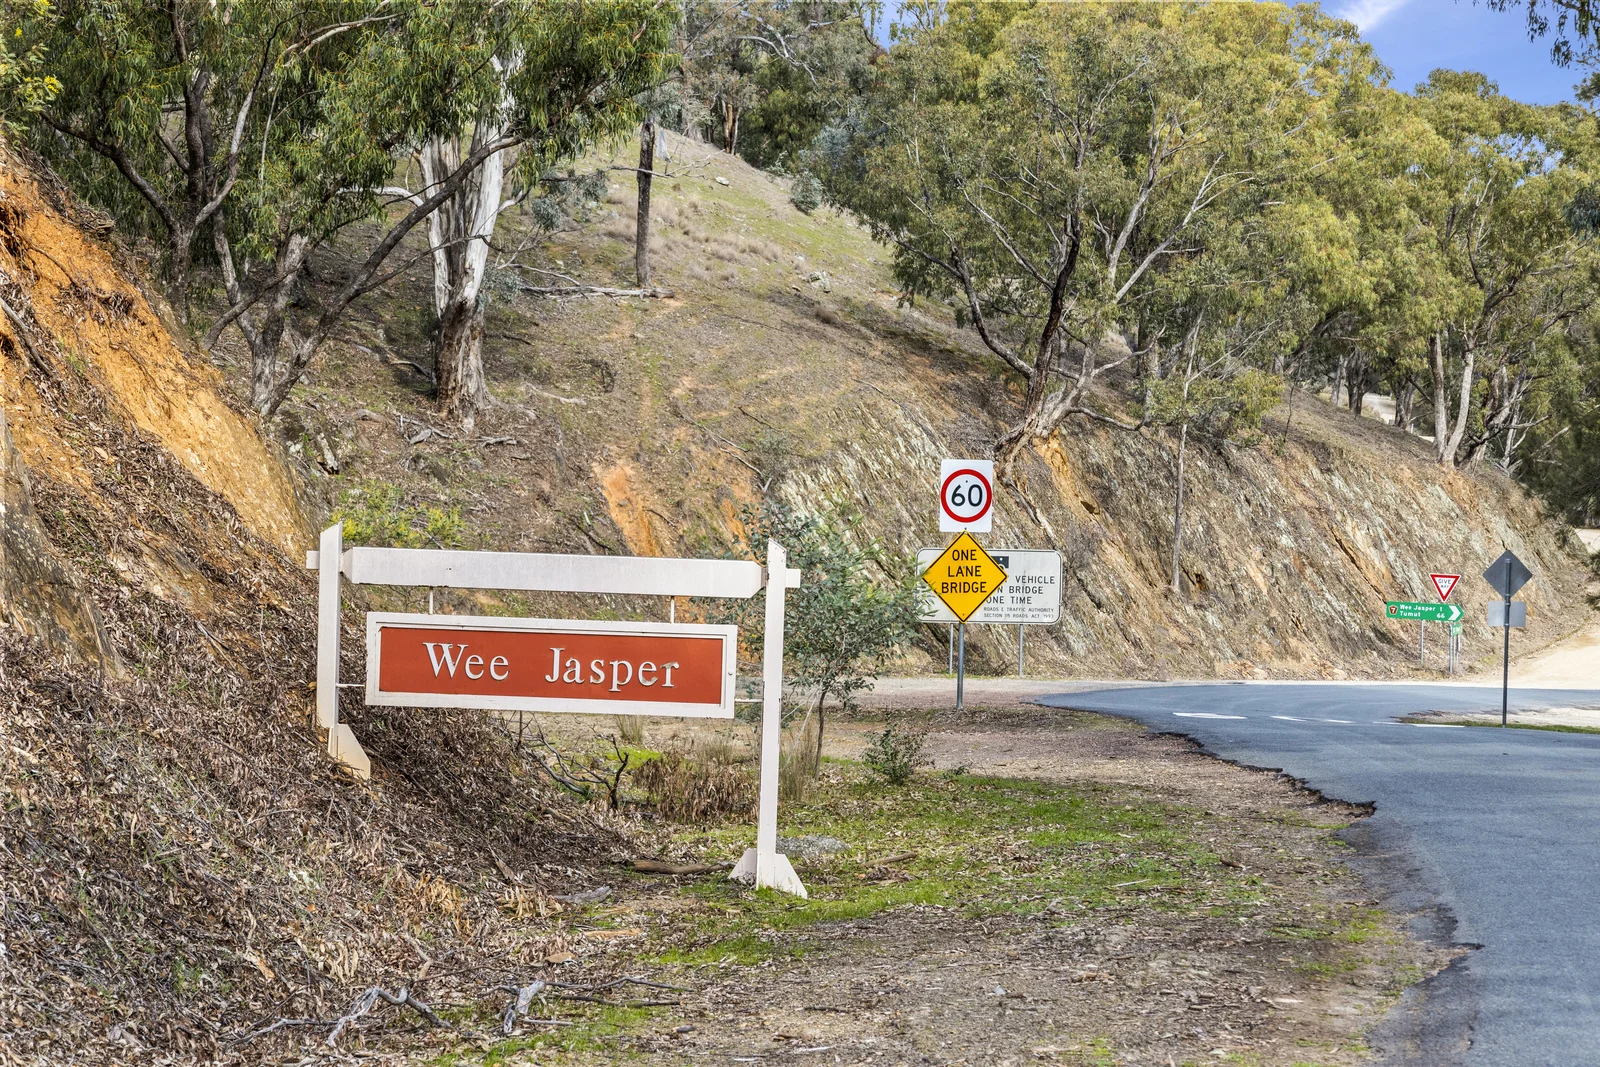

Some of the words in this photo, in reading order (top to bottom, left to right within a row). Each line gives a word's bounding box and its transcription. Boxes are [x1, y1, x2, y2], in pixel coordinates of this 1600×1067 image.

[951, 484, 983, 507] 60
[952, 549, 977, 561] ONE
[947, 566, 982, 578] LANE
[1015, 575, 1055, 584] VEHICLE
[941, 582, 987, 594] BRIDGE
[1009, 585, 1044, 594] BRIDGE
[1010, 596, 1032, 604] TIME
[422, 642, 510, 681] Wee
[545, 647, 680, 692] Jasper
